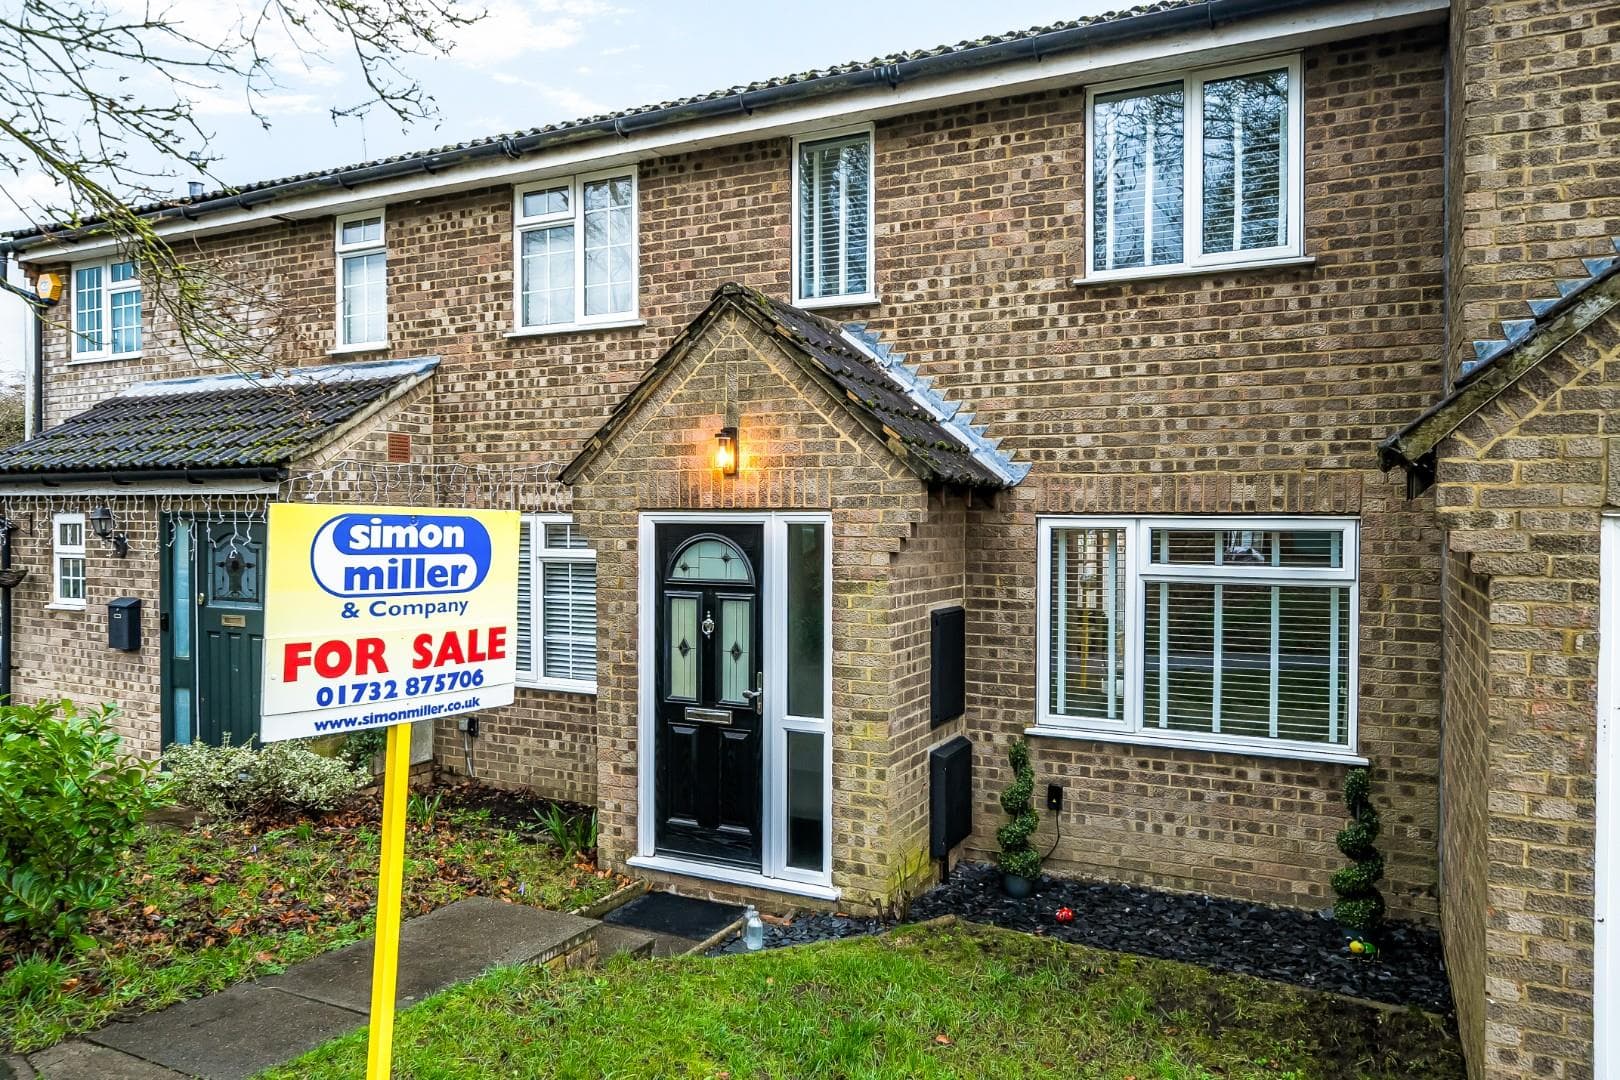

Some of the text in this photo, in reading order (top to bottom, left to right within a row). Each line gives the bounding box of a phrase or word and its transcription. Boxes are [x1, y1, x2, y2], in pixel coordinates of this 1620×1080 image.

[349, 517, 465, 550] simon
[343, 557, 468, 592] miller
[341, 600, 469, 619] & Company
[283, 626, 507, 683] FOR SALE
[316, 668, 485, 707] 01732 875706
[314, 696, 481, 732] www.simonmiller.co.uk
